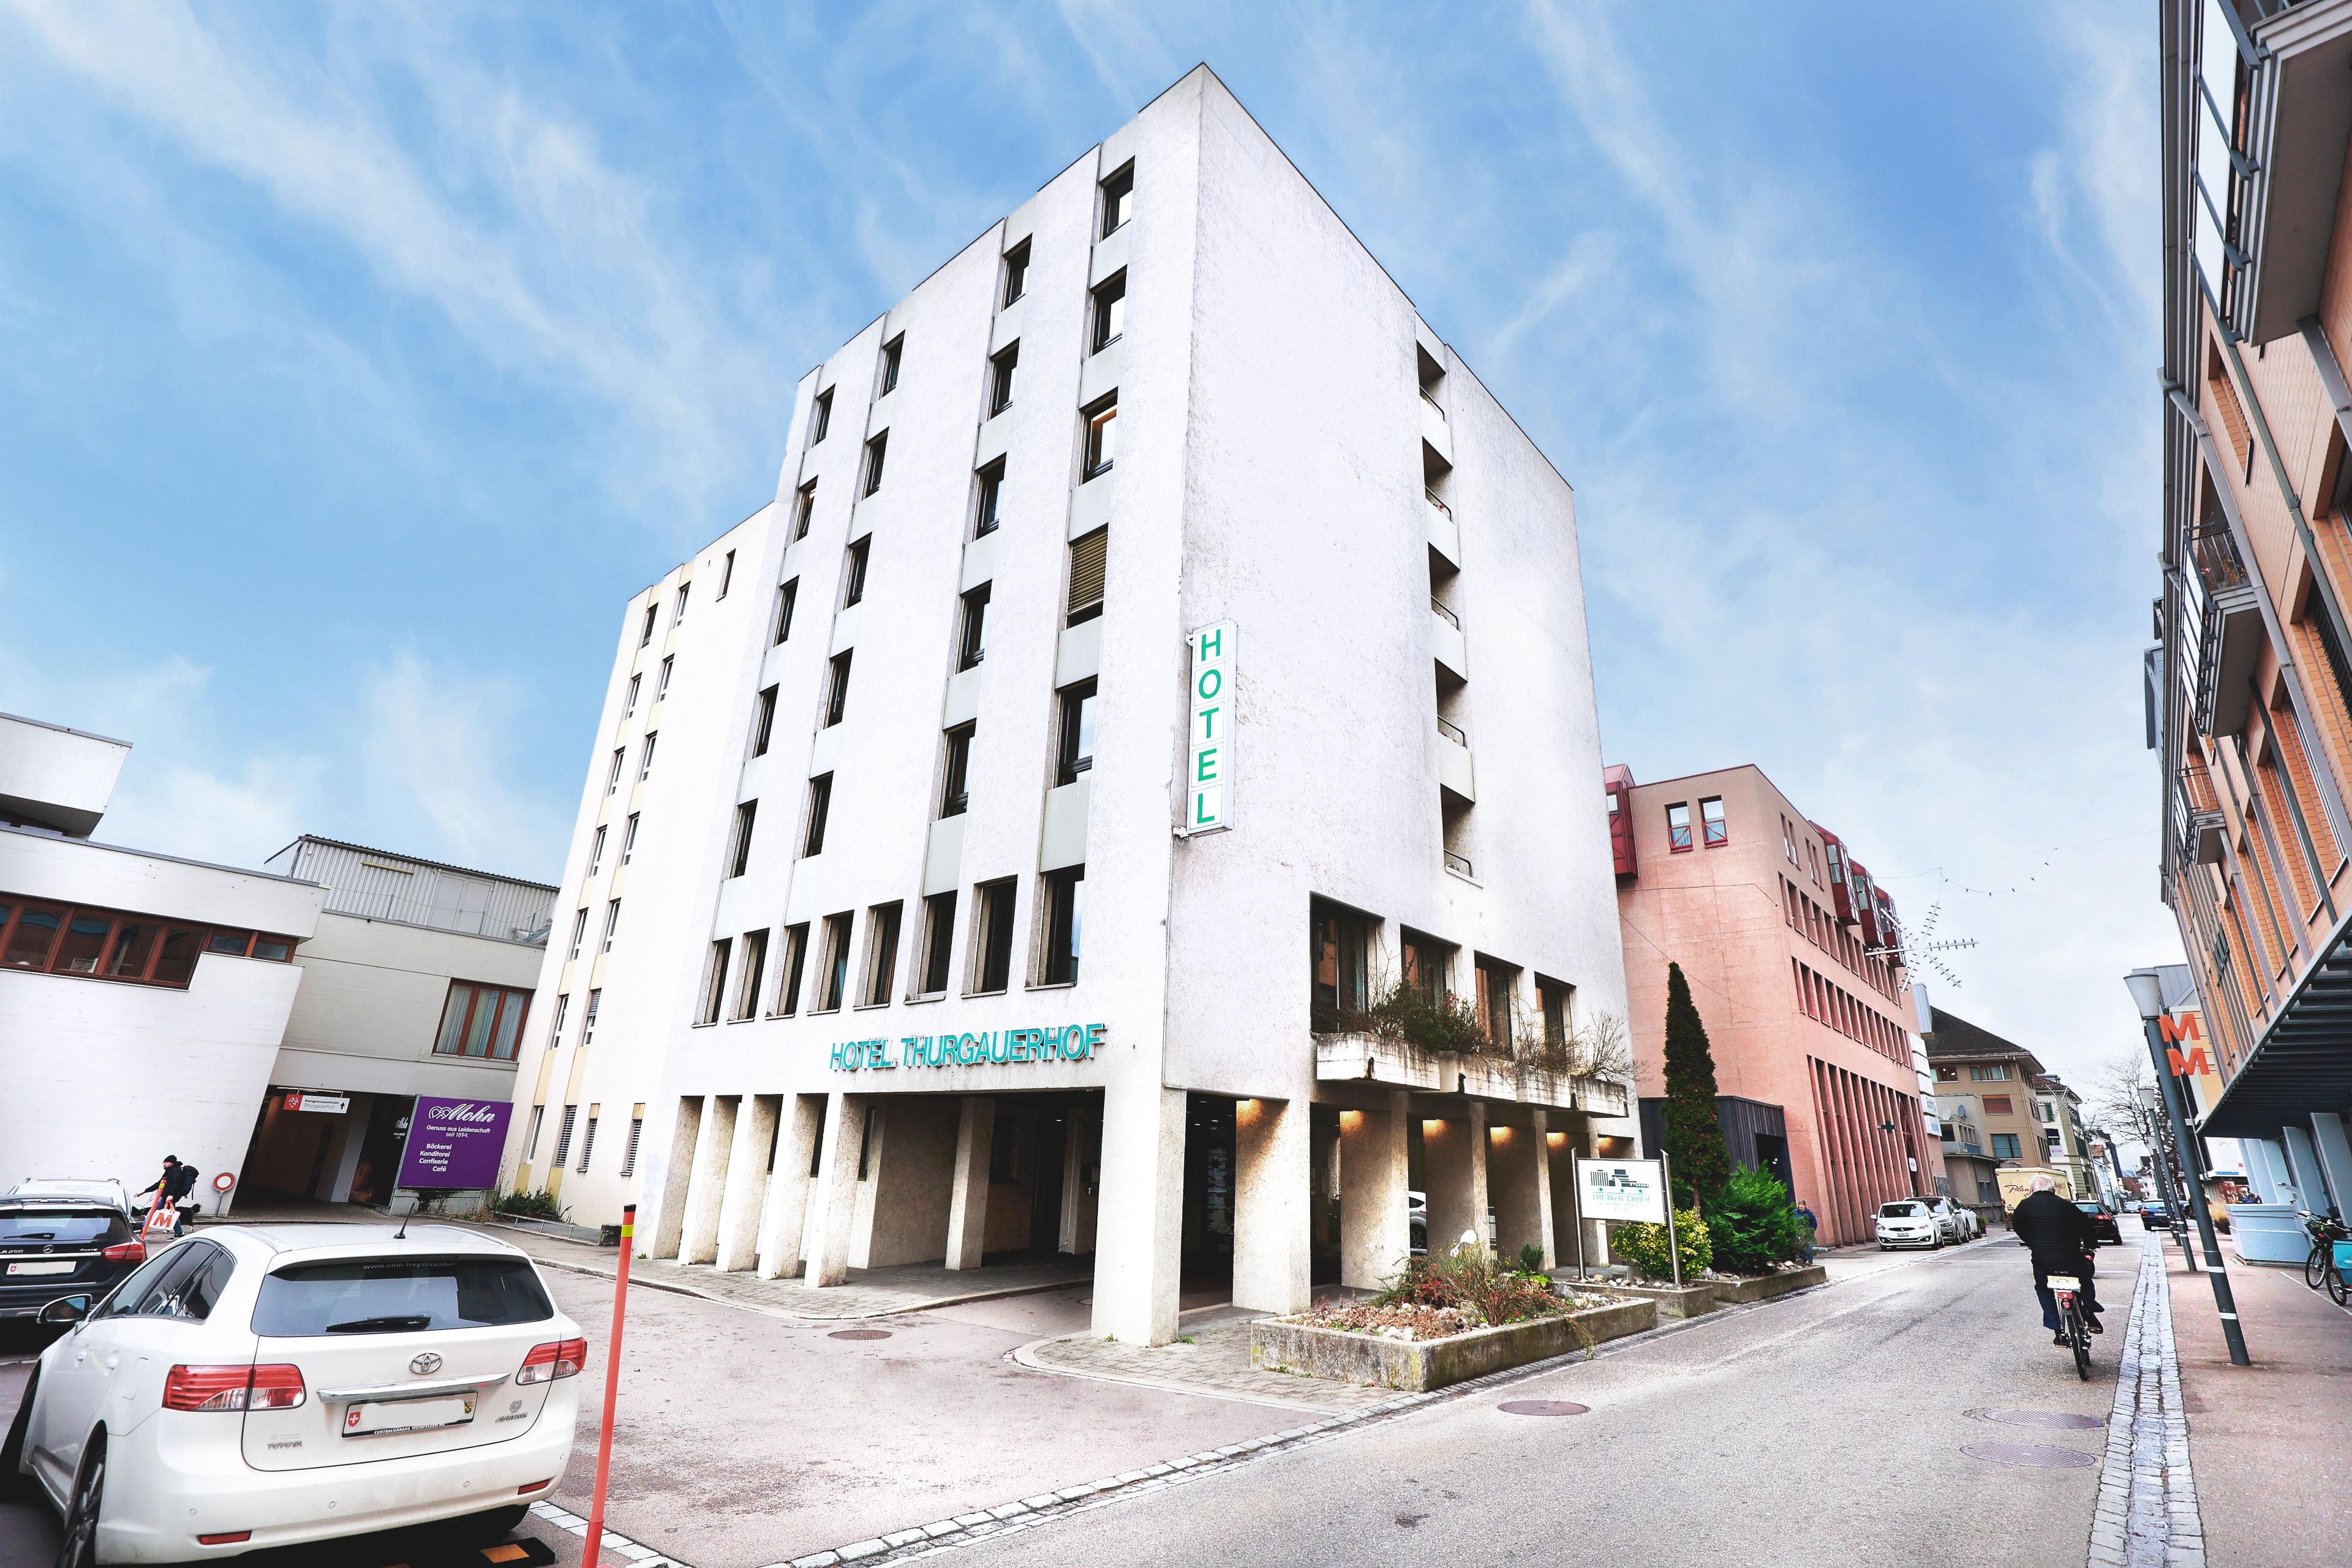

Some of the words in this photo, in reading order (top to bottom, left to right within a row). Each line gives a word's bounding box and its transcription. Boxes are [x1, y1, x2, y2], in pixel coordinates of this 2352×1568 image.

[1197, 628, 1221, 824] HOTEL
[829, 1039, 892, 1071] HOTEL
[900, 1022, 1103, 1067] THURGAUERHOF
[448, 1103, 495, 1123] Mohn
[153, 1212, 173, 1227] M
